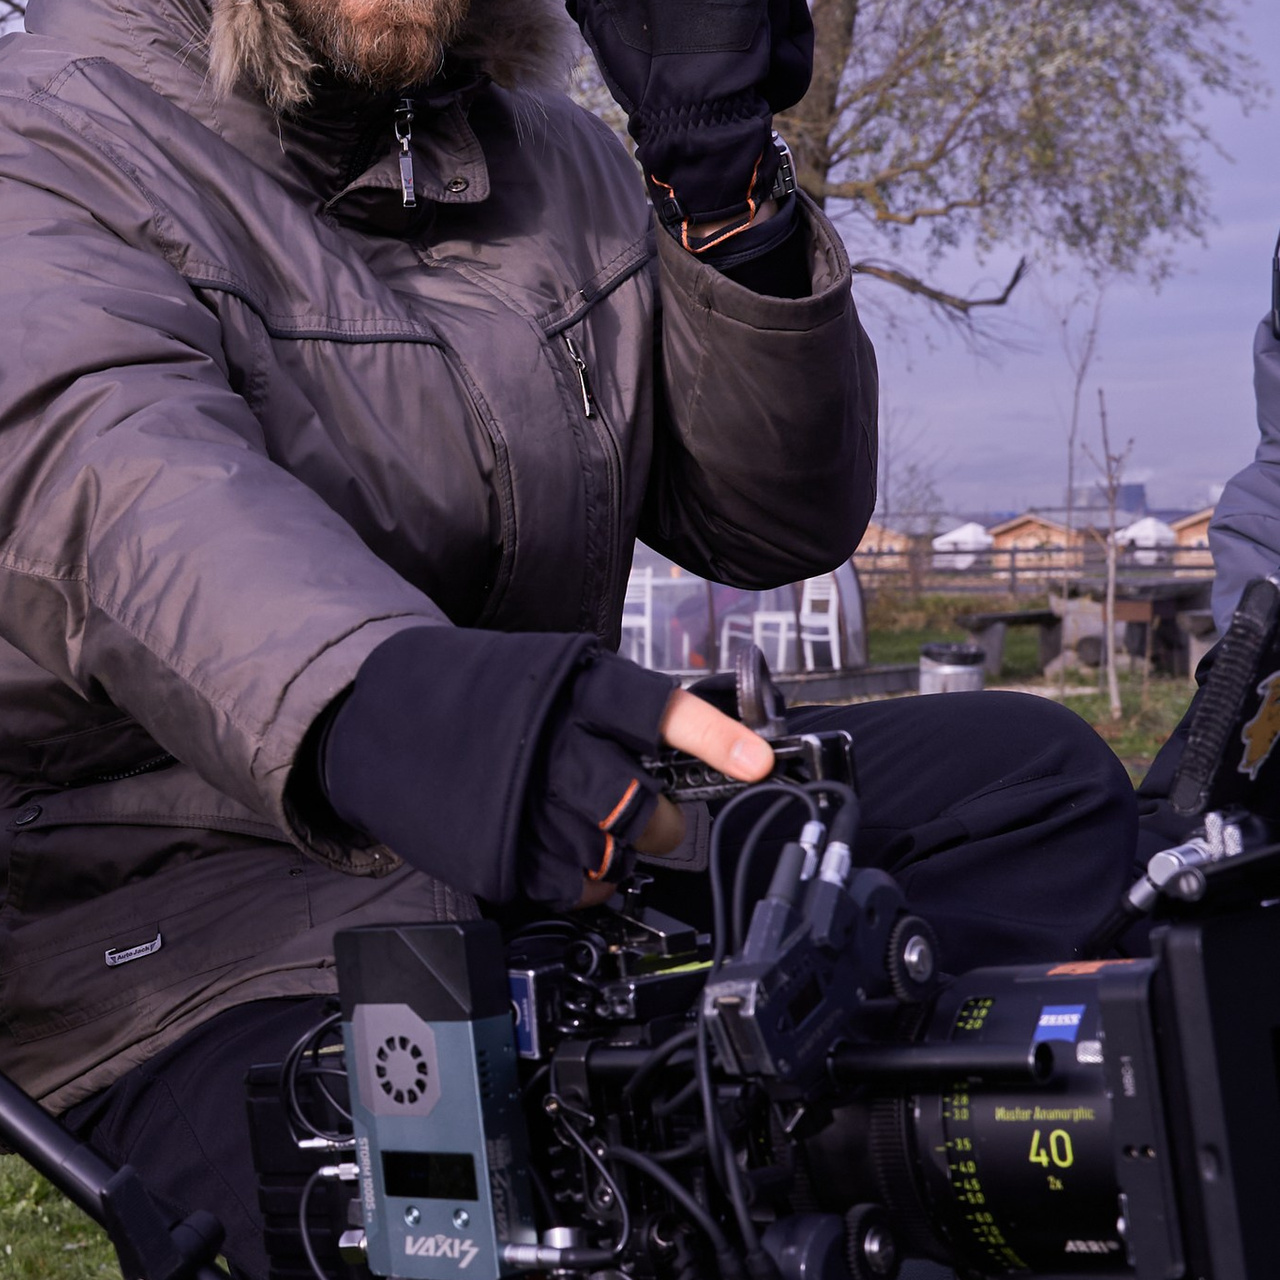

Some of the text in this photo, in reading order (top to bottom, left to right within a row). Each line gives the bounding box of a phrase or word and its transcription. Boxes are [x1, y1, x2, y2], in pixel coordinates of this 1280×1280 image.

[116, 951, 133, 961] Auto
[359, 1136, 372, 1176] STORM
[1028, 1128, 1075, 1169] 40
[404, 1234, 481, 1269] VAXIS
